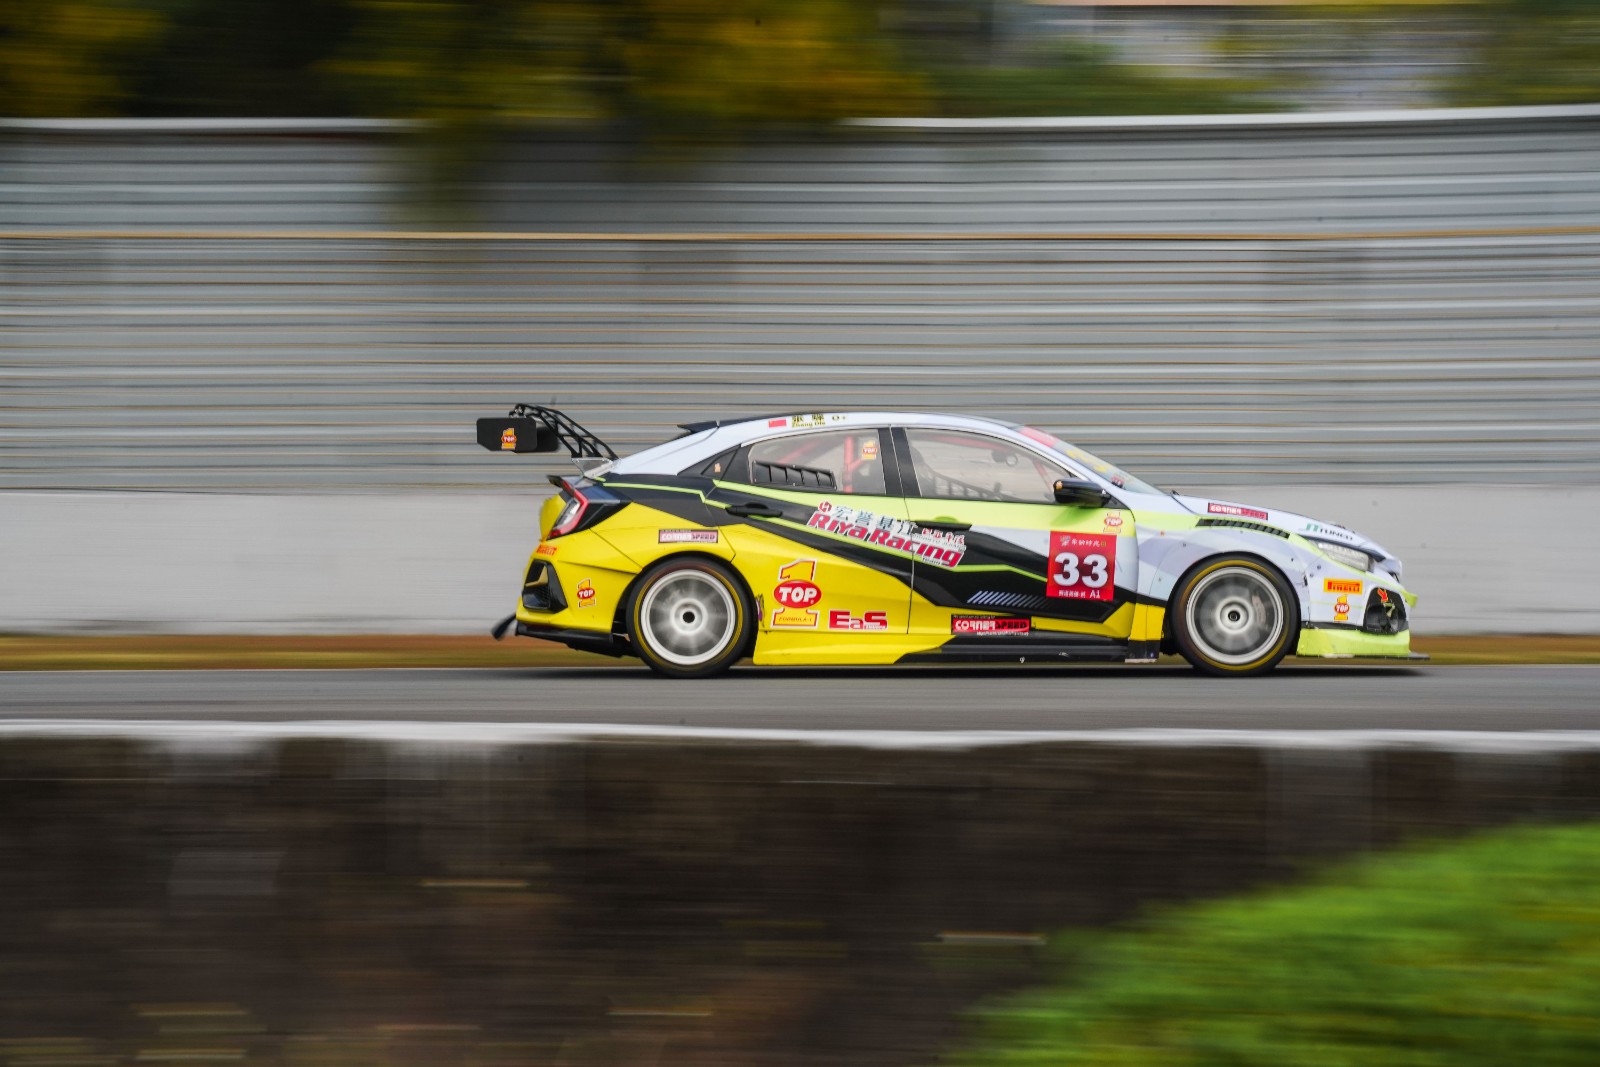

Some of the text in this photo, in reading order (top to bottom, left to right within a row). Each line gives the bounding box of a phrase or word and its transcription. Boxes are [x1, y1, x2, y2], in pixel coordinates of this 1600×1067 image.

[808, 513, 868, 539] Riya
[868, 528, 962, 568] Racing
[1053, 552, 1109, 589] 33
[578, 589, 594, 598] TOP
[778, 587, 817, 603] TOP
[1327, 581, 1360, 593] PIRELLI
[1335, 604, 1349, 613] TOP
[829, 610, 888, 629] EaS
